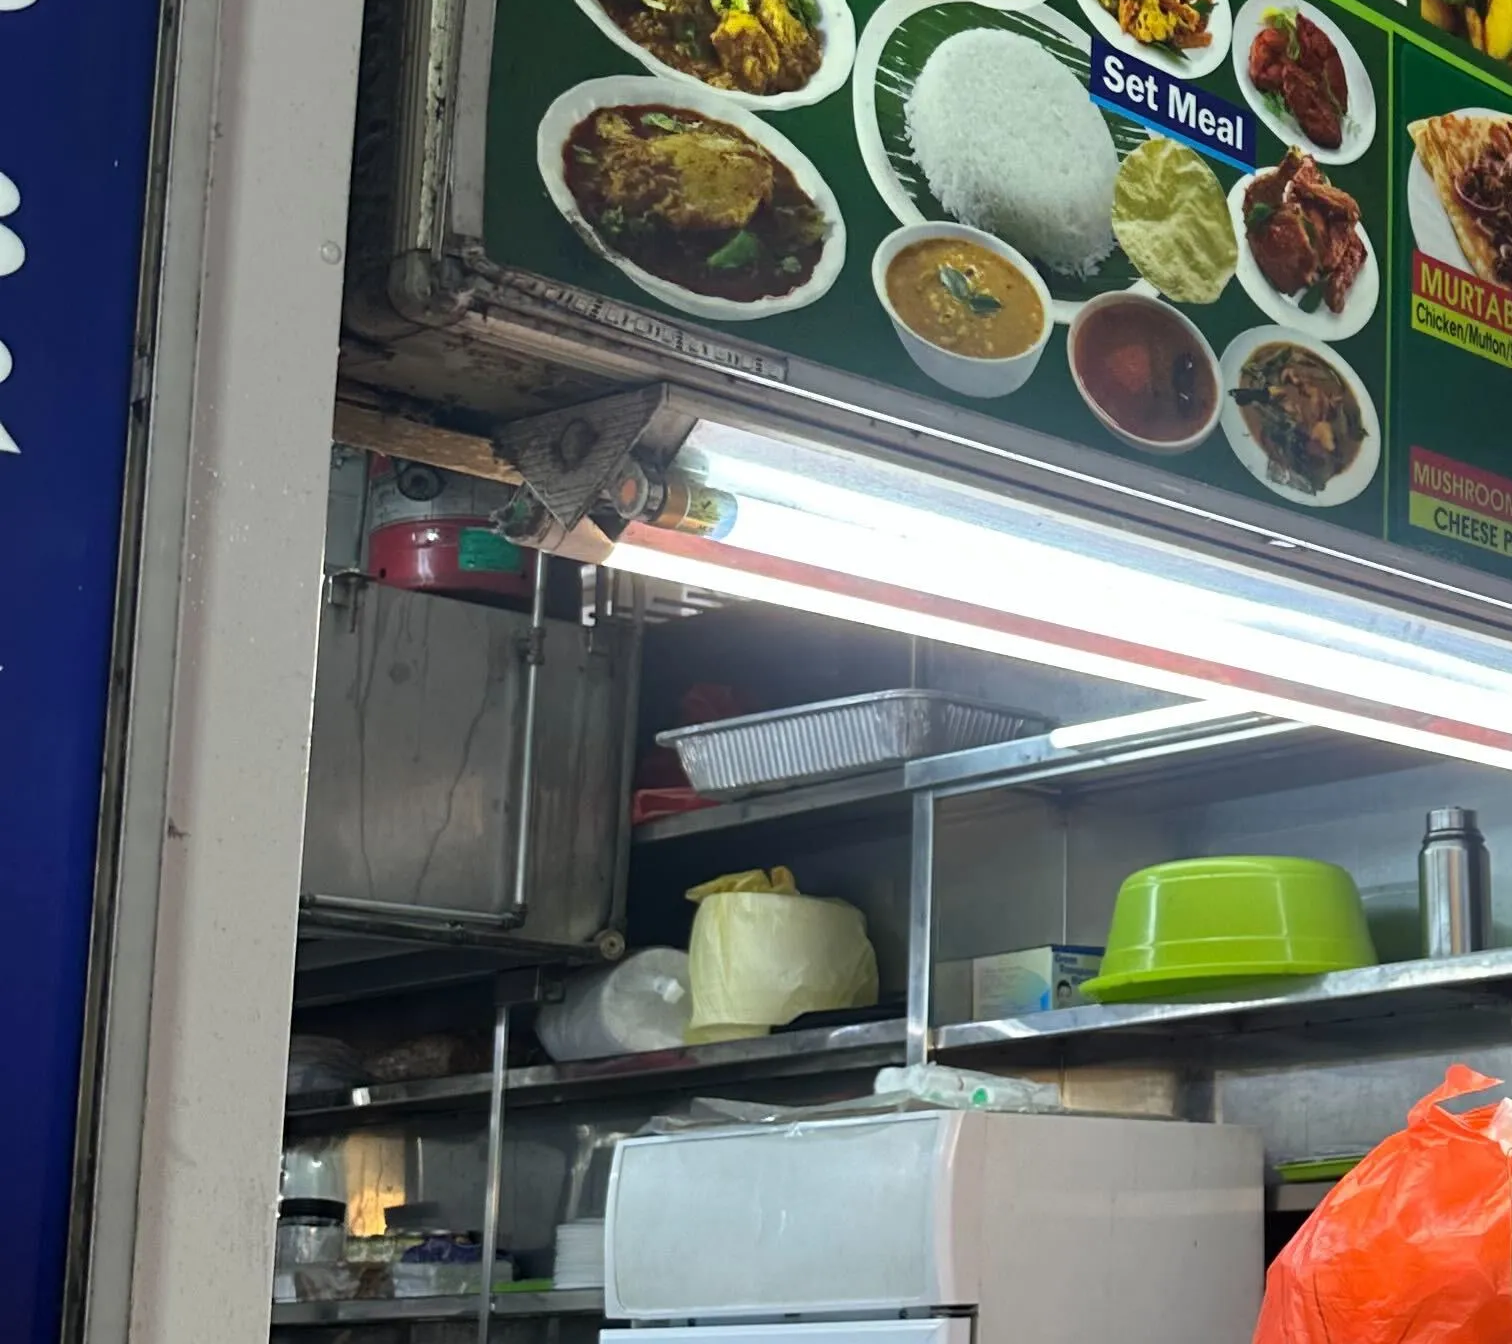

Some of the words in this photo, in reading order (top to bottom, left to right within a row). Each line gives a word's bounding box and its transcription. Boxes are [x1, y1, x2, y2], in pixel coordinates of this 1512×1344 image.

[1103, 55, 1158, 113] Set
[1168, 90, 1244, 152] Meal
[1434, 506, 1499, 553] CHEESE
